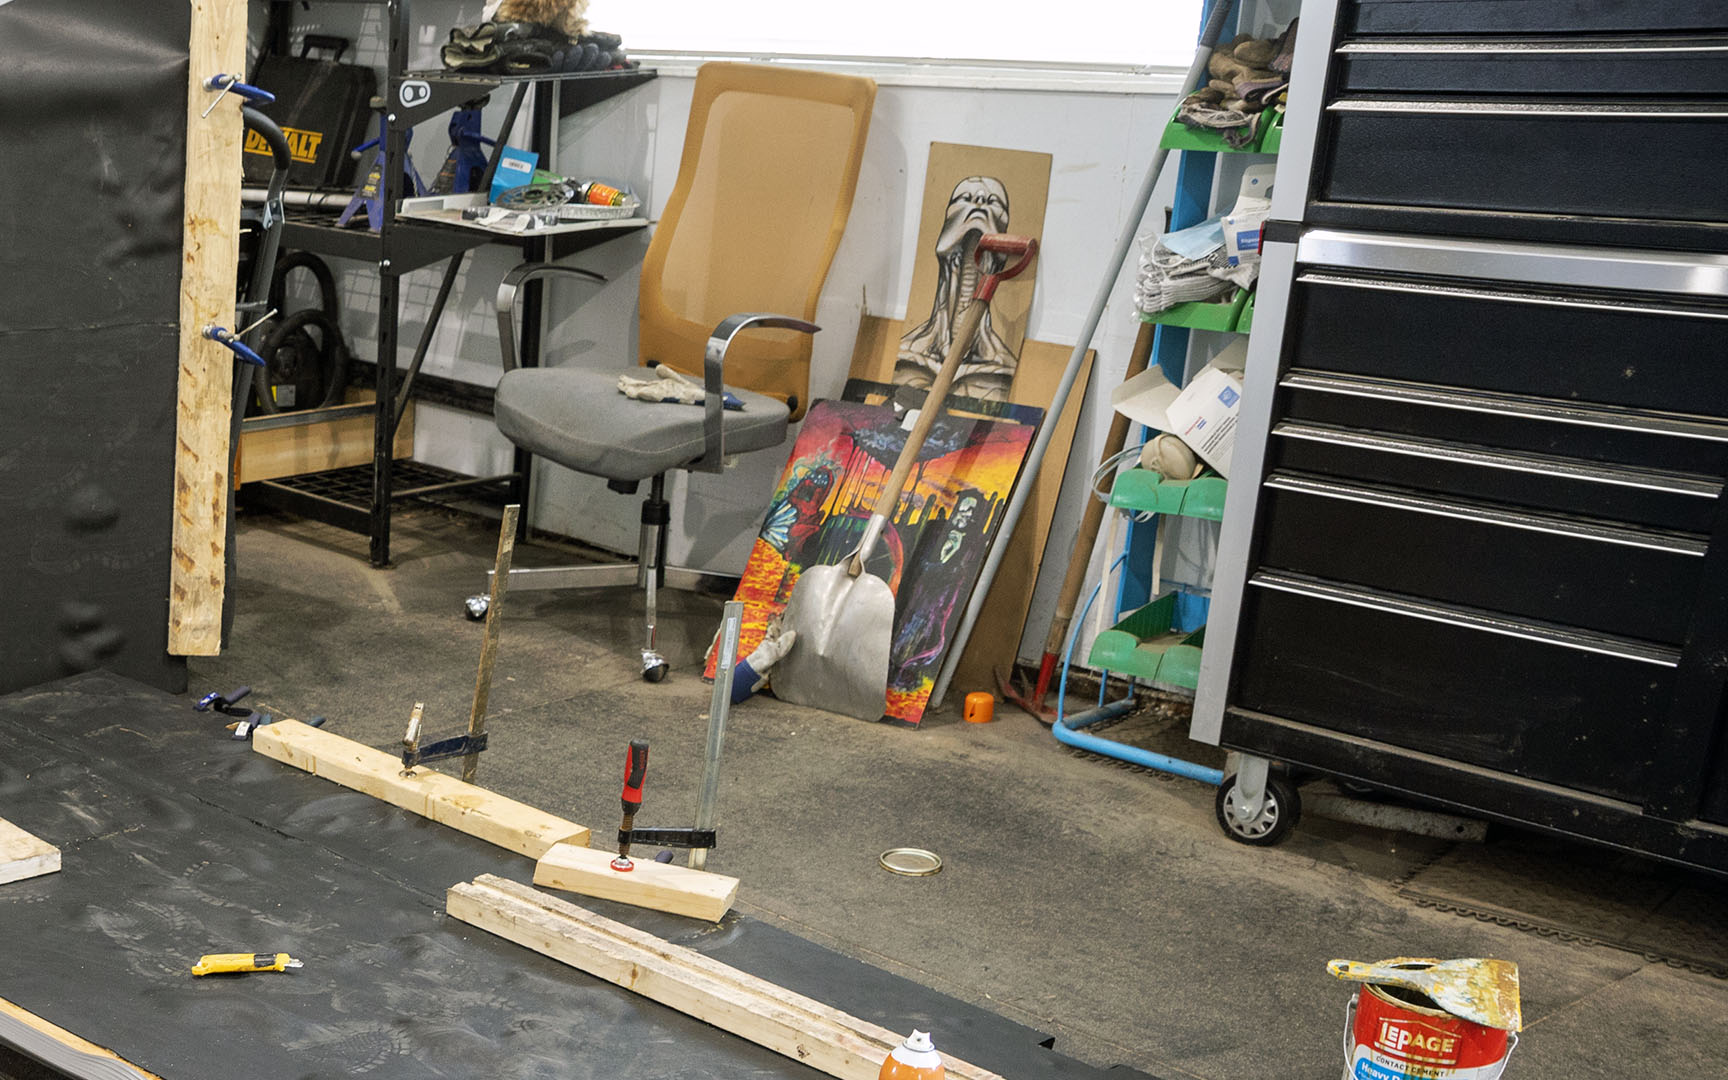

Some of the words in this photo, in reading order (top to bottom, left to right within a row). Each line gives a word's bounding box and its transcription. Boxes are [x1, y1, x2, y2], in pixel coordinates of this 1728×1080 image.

[245, 129, 322, 160] DEALT
[1379, 1022, 1455, 1053] LEPAGE
[1376, 1056, 1409, 1071] CONTACT
[1411, 1067, 1445, 1077] CEMENT
